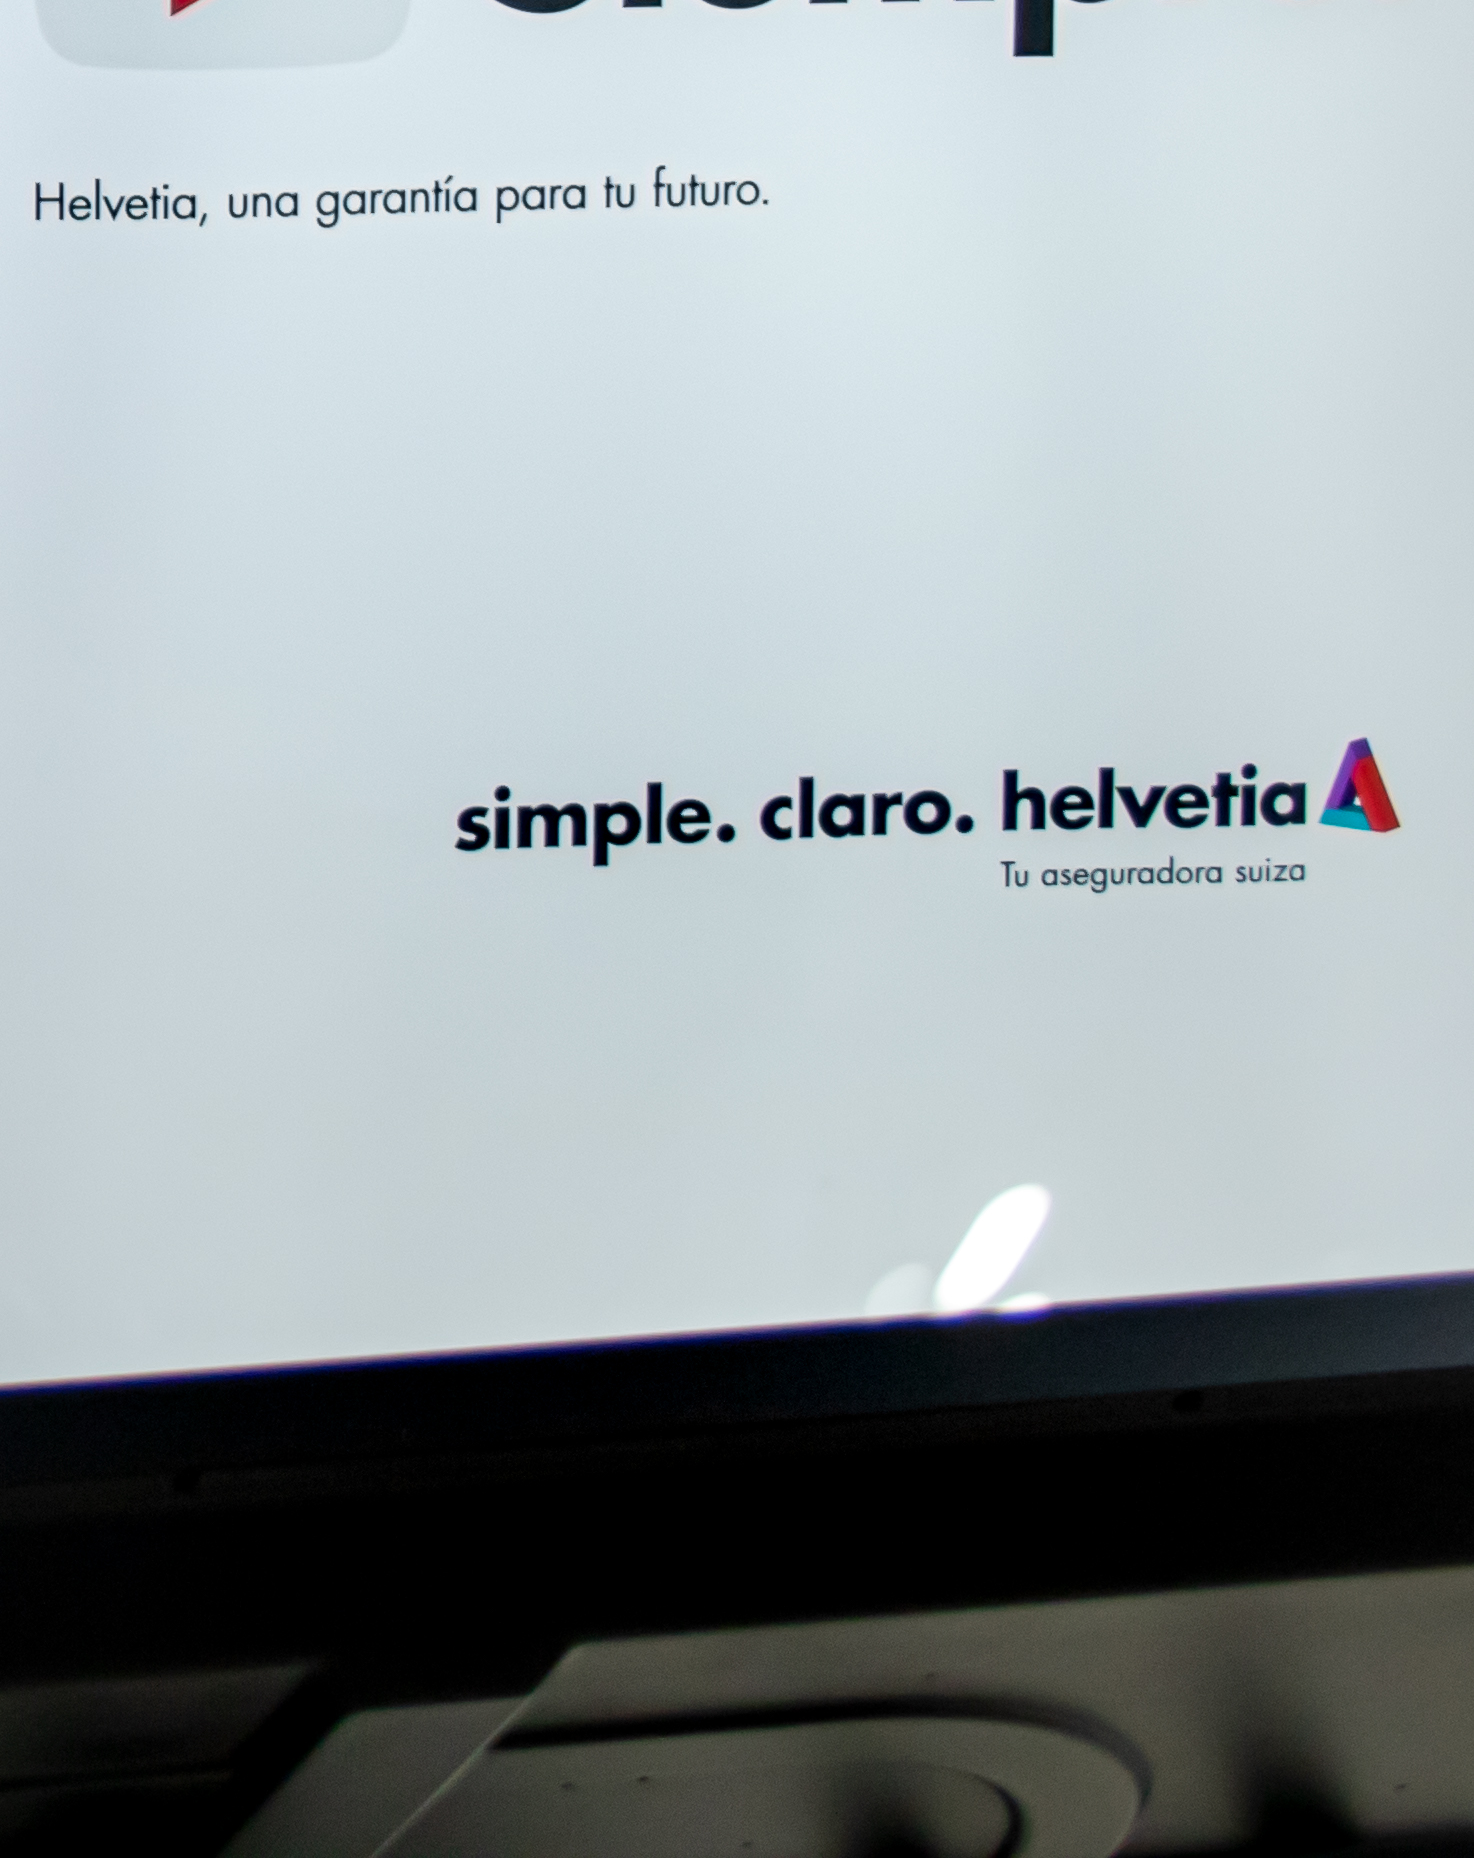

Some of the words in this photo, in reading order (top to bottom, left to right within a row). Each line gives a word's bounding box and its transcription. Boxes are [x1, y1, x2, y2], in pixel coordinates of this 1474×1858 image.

[35, 178, 207, 227] Helvetia,
[228, 192, 298, 219] una
[316, 175, 477, 229] garantía
[495, 184, 586, 224] para
[604, 176, 635, 210] tu
[653, 165, 770, 208] futuro.
[454, 781, 736, 867] simple.
[760, 776, 974, 841] claro.
[1002, 763, 1307, 831] helvetia
[1000, 860, 1028, 887] Tu
[1041, 856, 1222, 894] aseguradora
[1235, 859, 1305, 885] suiza
